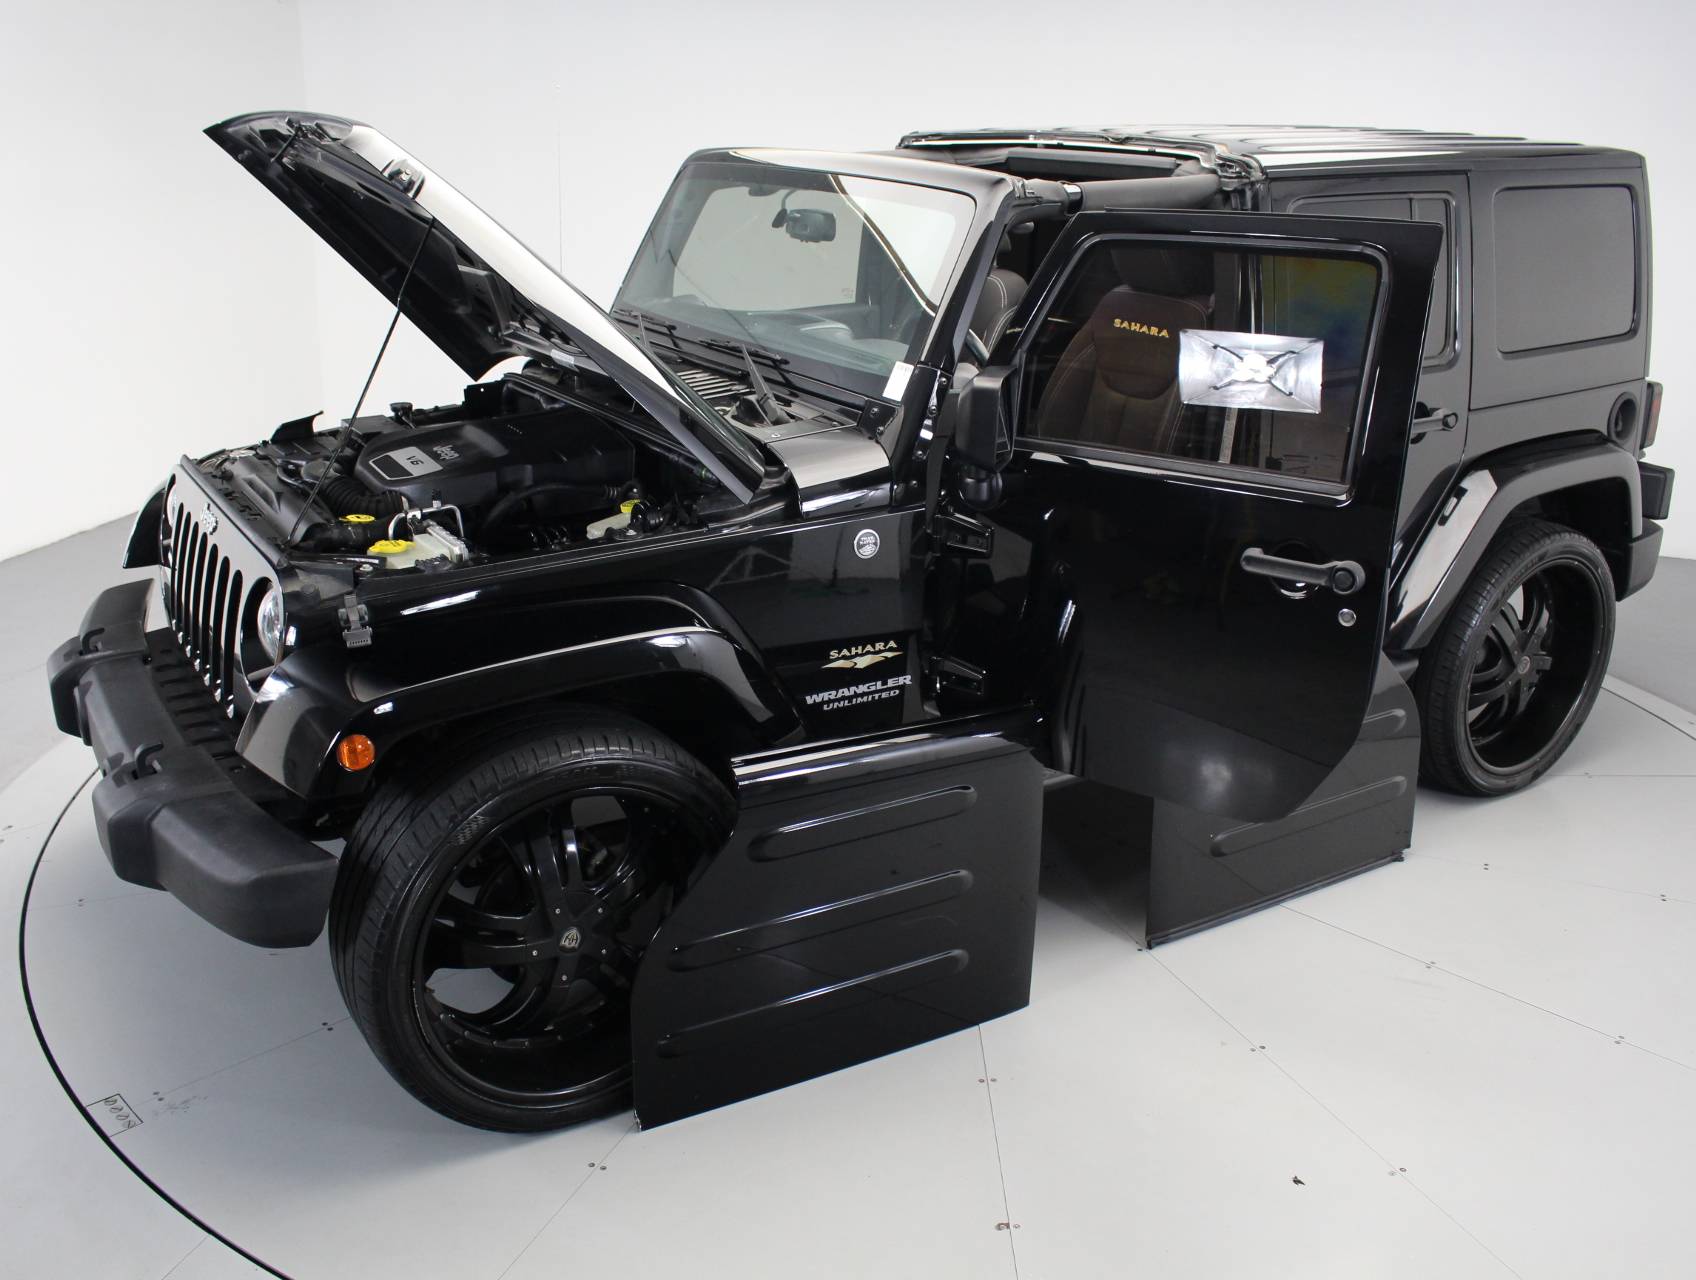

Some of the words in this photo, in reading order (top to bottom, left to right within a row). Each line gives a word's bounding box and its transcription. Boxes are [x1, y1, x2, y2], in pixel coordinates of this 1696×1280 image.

[1113, 318, 1169, 338] SAHARA
[829, 640, 898, 660] SAHARA
[805, 674, 912, 705] WRANGLER
[823, 689, 900, 711] UNLIMITED
